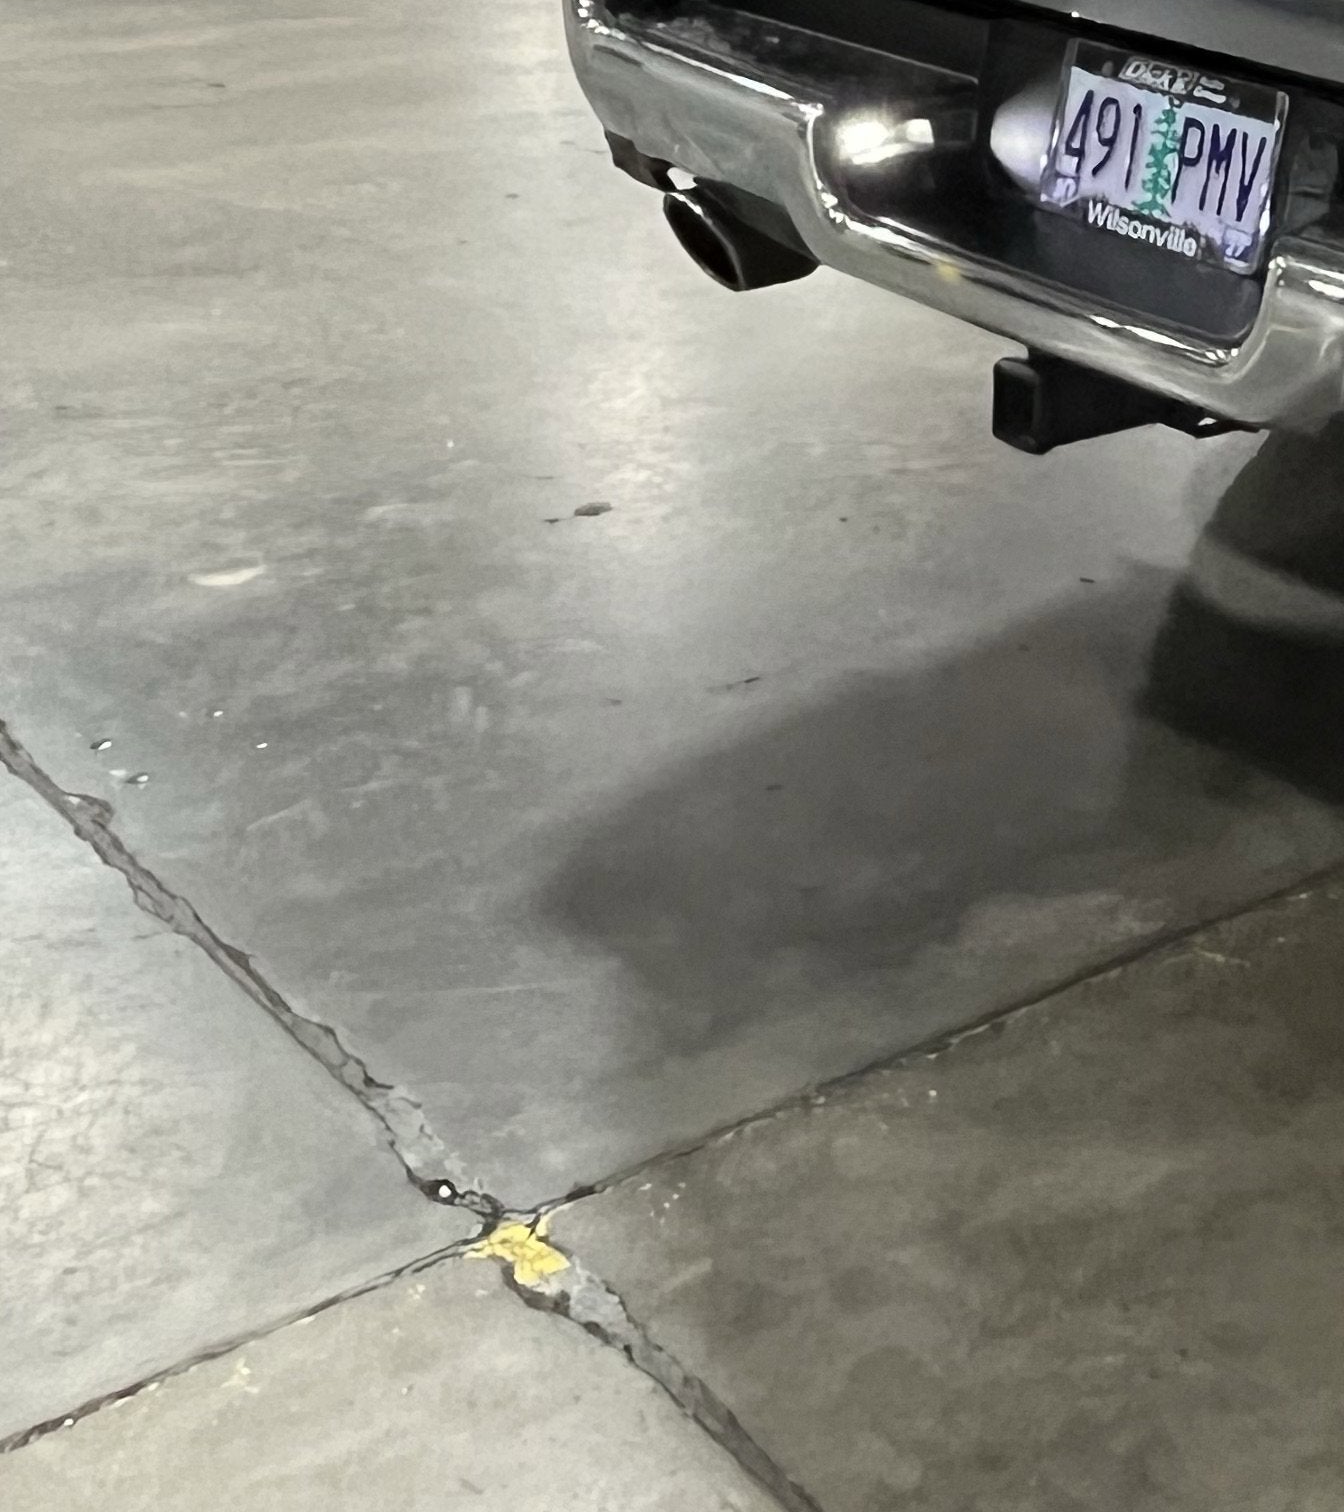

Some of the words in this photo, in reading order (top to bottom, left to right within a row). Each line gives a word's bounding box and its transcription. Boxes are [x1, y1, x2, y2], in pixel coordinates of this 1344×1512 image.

[1065, 89, 1142, 192] 491
[1171, 117, 1267, 222] PMV
[1087, 200, 1198, 258] Wilsonville
